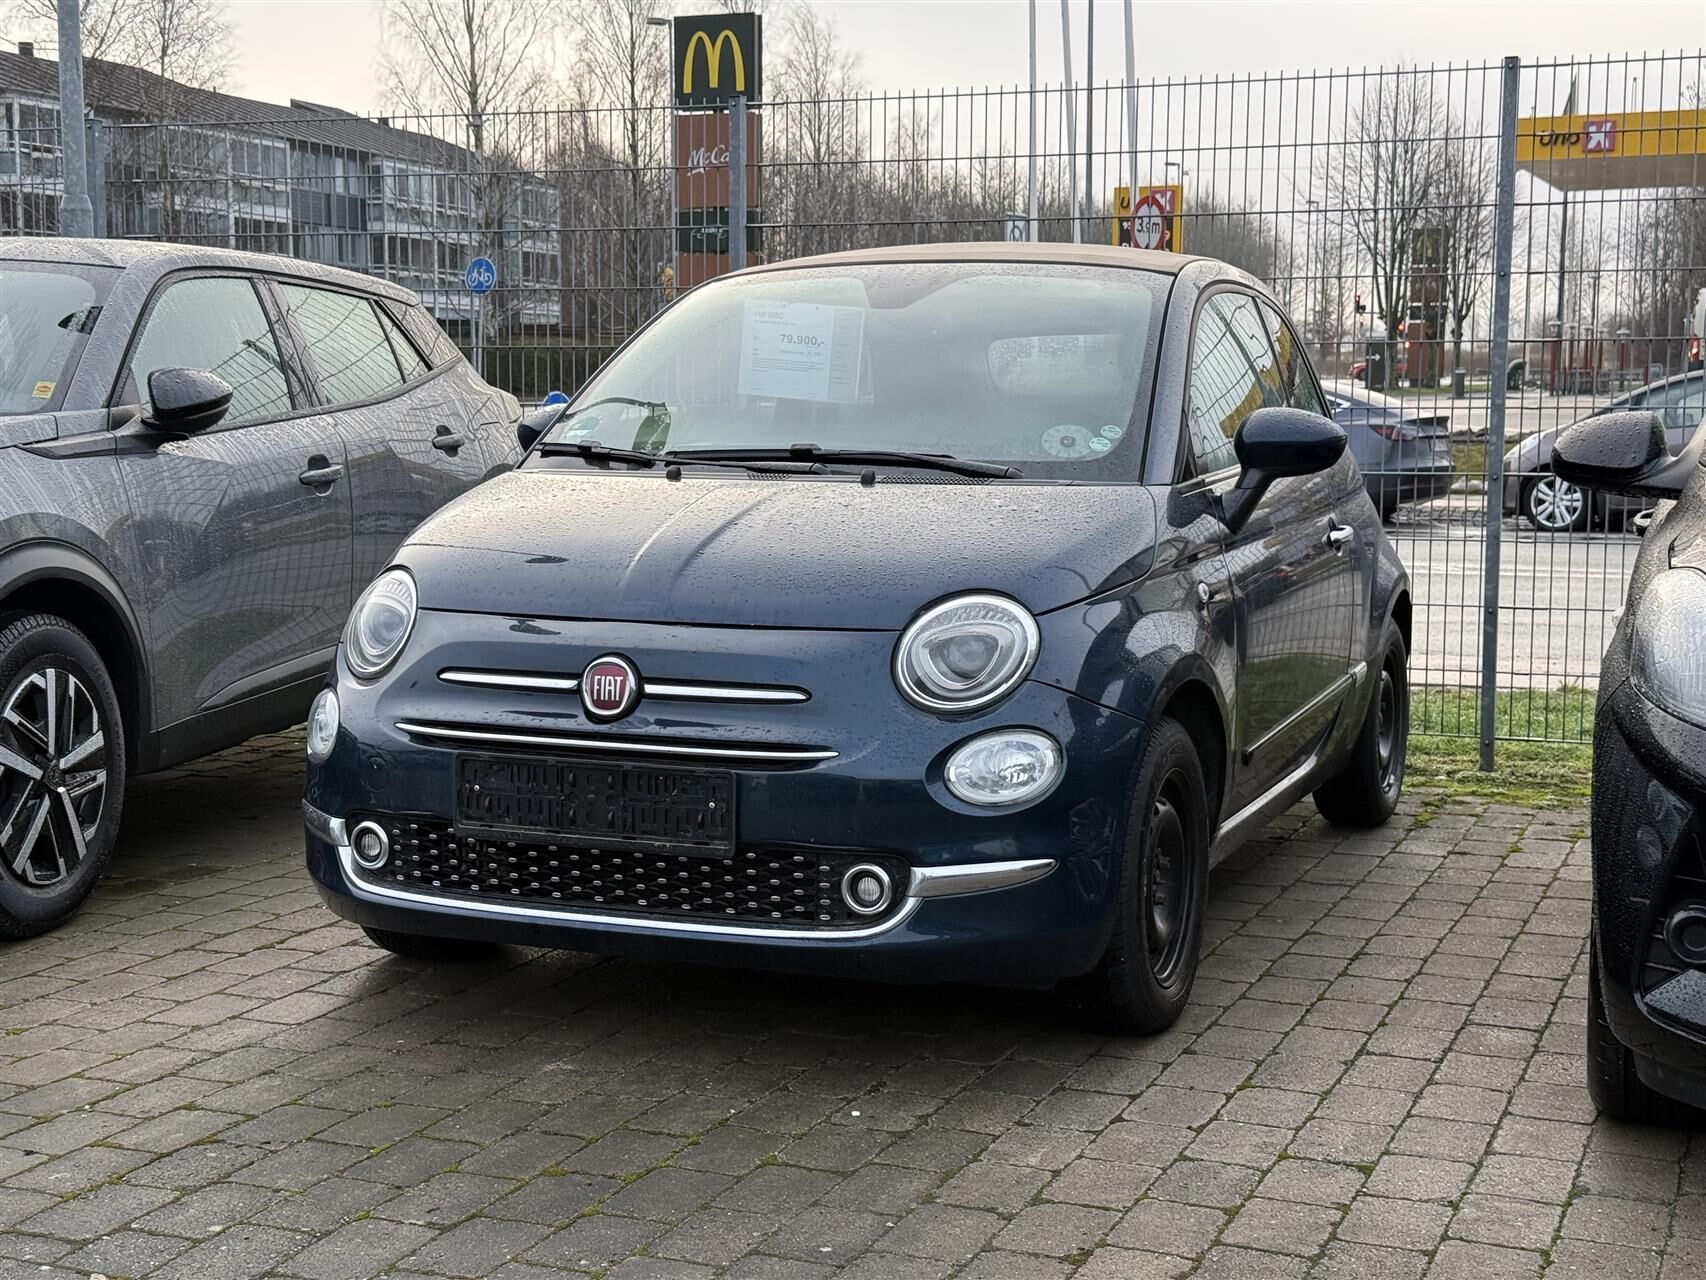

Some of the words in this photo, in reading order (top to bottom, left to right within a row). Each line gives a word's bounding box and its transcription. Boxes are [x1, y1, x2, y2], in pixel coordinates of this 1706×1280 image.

[687, 144, 730, 169] McCa
[779, 334, 825, 347] 79.900,-
[593, 675, 624, 701] FIAT
